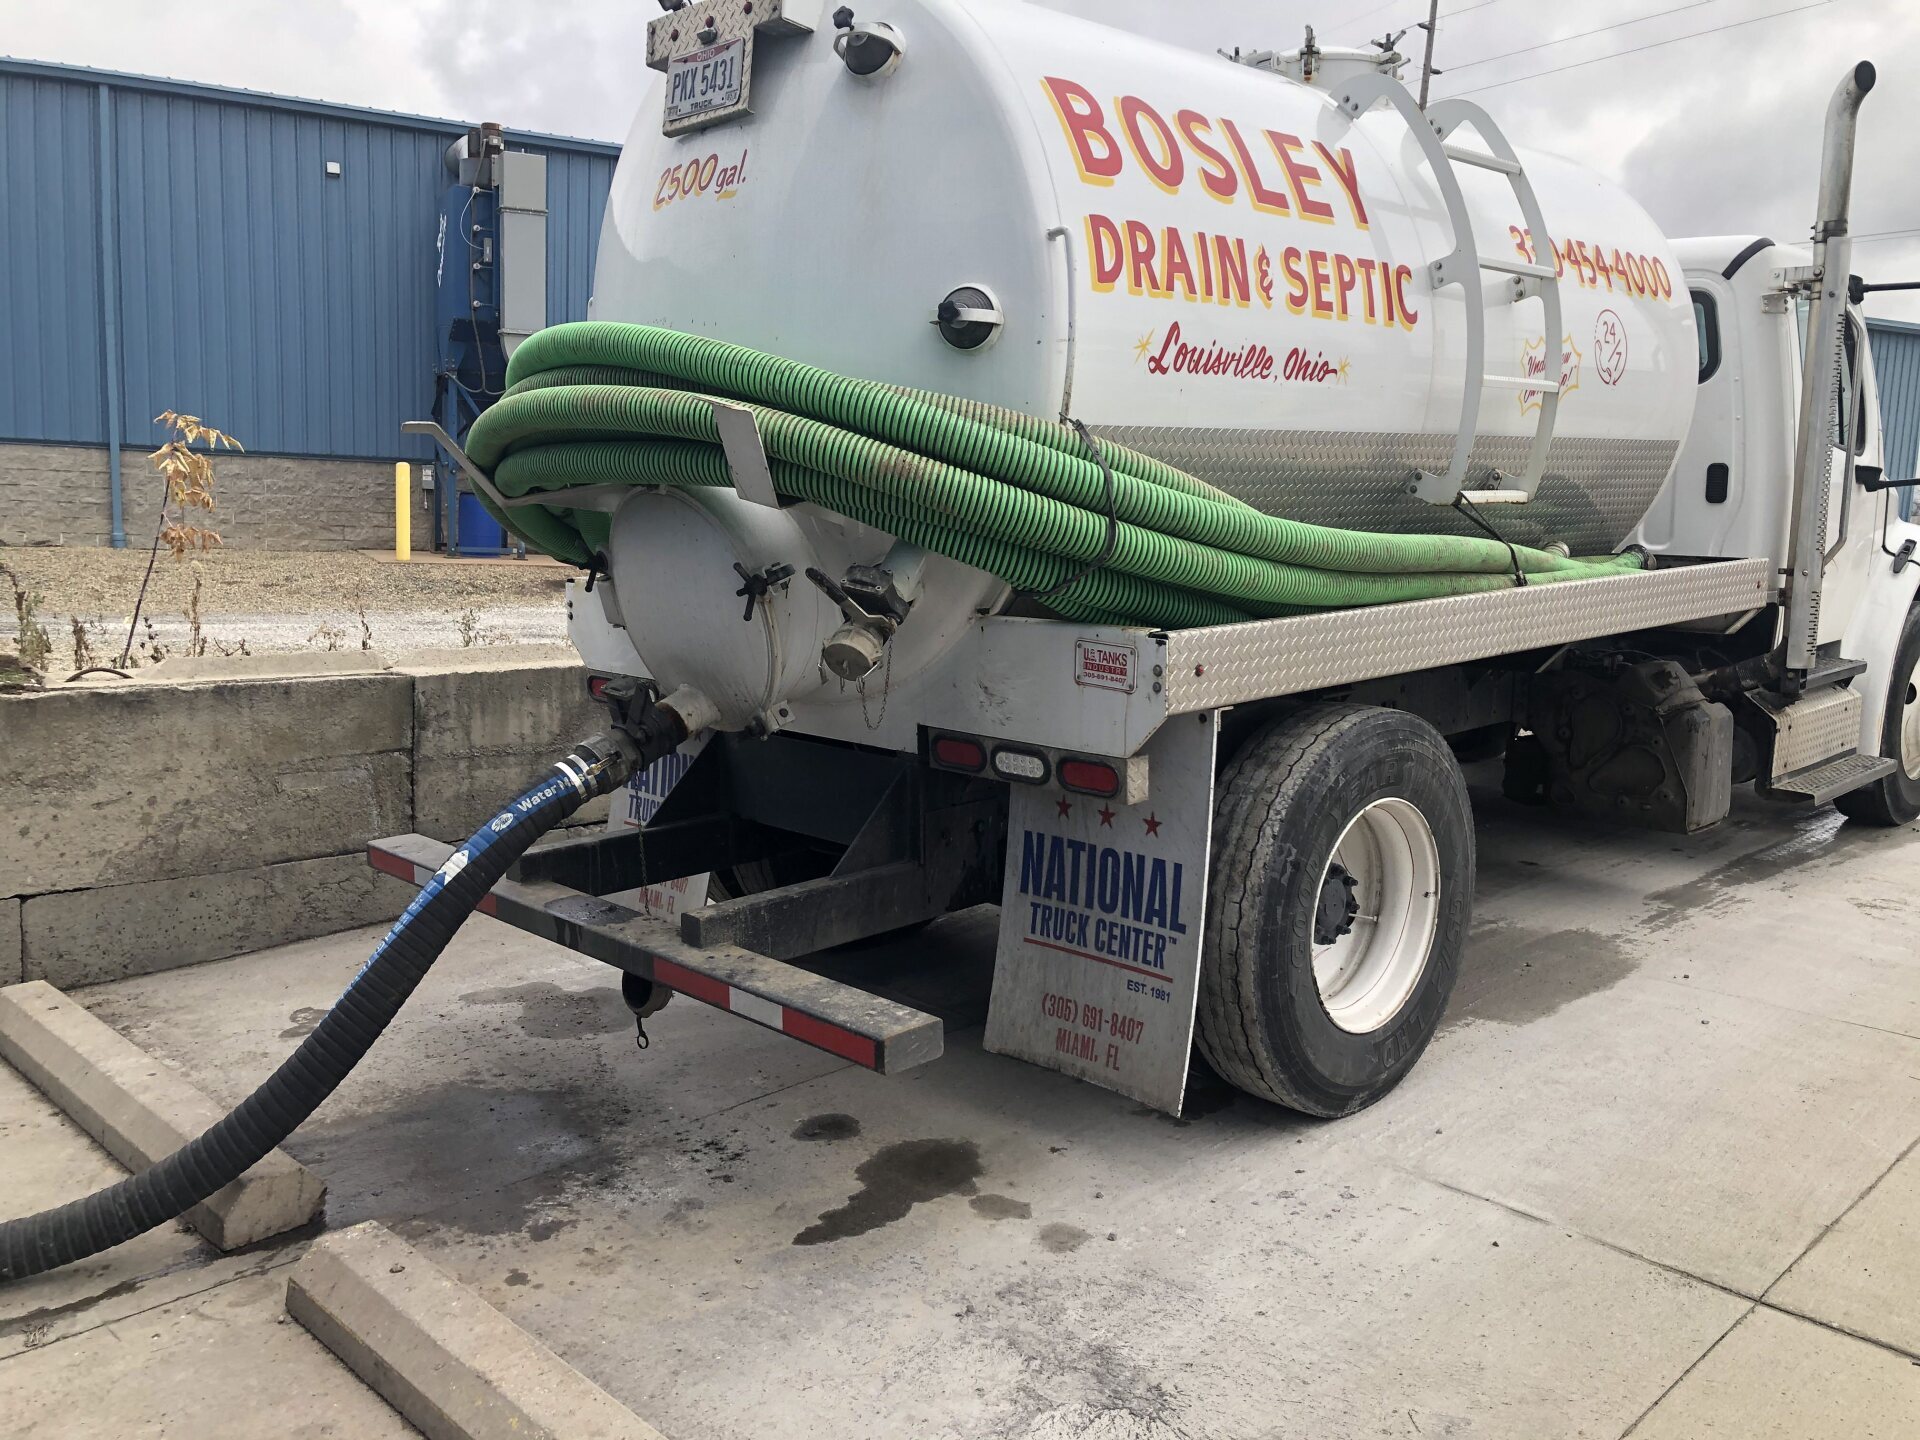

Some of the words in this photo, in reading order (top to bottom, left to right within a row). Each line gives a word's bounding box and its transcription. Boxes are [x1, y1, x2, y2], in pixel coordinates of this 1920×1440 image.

[696, 49, 715, 62] OHIO
[671, 67, 698, 104] PKX
[700, 56, 734, 96] 5431
[690, 98, 713, 110] TRUCK
[1040, 76, 1370, 231] BOSLEY
[653, 153, 719, 212] 2500
[714, 149, 748, 194] gal.
[1084, 213, 1252, 308] DRAIN
[1254, 243, 1275, 309] &
[1281, 246, 1419, 332] SEPTIC
[1148, 321, 1279, 383] Louisville,
[1283, 347, 1338, 383] Ohio
[1083, 661, 1128, 676] INDUSTRY
[1097, 649, 1128, 667] TANKS
[516, 784, 557, 812] Water
[1020, 830, 1187, 935] NATIONAL
[1030, 901, 1090, 949] TRUCK
[1094, 918, 1165, 970] CENTER
[1127, 979, 1147, 996] EST.
[1150, 987, 1171, 1003] 1981
[1041, 992, 1079, 1024] (305)
[1082, 1003, 1144, 1045] 691-8407
[1105, 1043, 1120, 1071] FL
